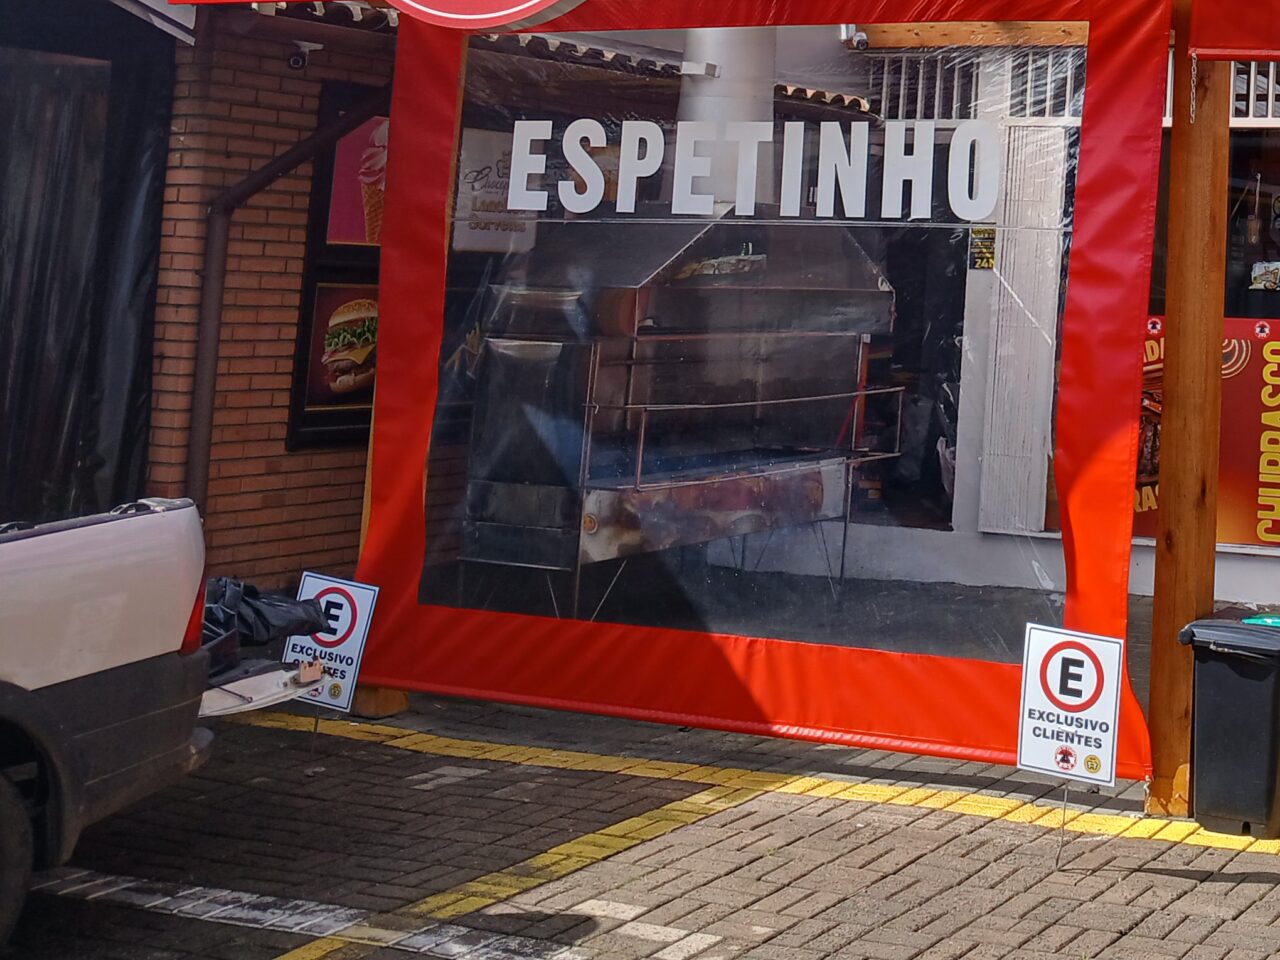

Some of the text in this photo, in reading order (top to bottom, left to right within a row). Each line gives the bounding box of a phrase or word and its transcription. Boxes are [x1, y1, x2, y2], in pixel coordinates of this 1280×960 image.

[506, 118, 1000, 221] ESPETINHO
[322, 600, 344, 636] E
[291, 643, 354, 666] EXCLUSIVO
[1058, 656, 1085, 699] E
[1027, 708, 1110, 734] EXCLUSIVO
[1032, 726, 1103, 750] CLIENTES
